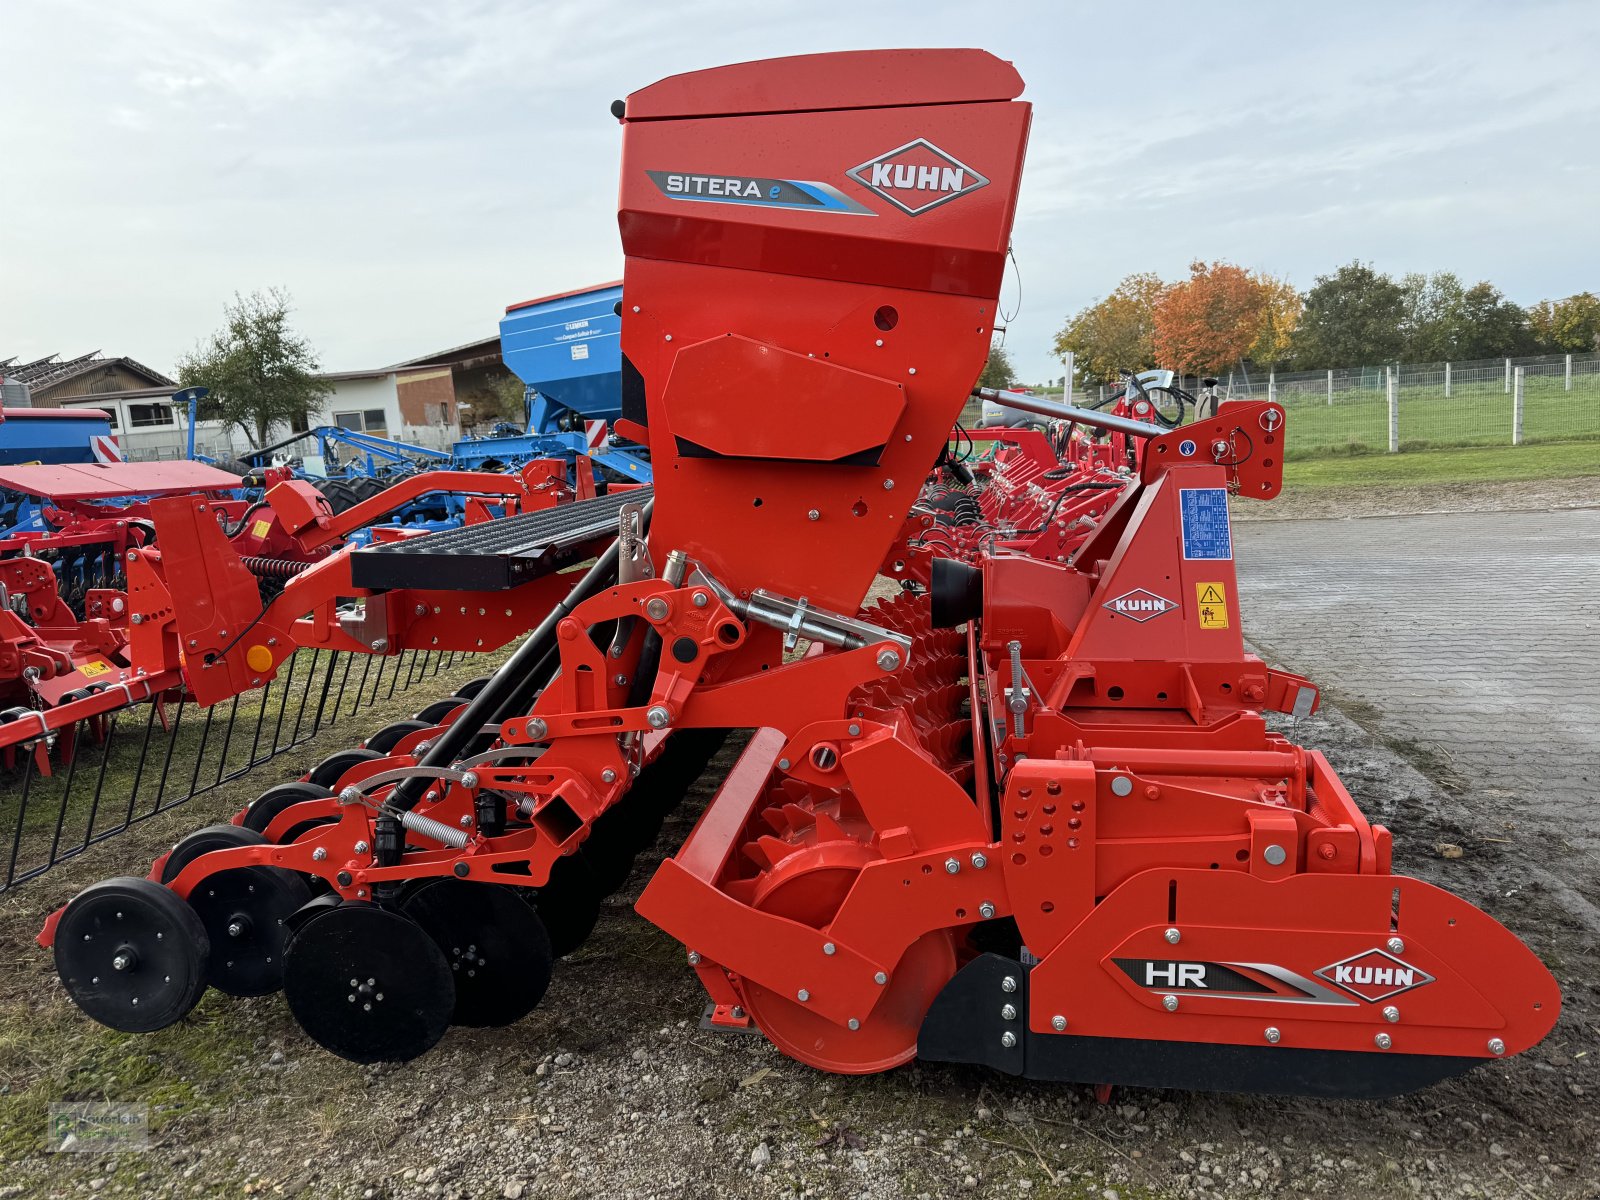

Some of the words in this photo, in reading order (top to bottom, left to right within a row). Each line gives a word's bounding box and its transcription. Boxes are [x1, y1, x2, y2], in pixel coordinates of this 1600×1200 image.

[666, 175, 762, 199] SITERA
[768, 183, 782, 199] e
[870, 163, 964, 193] KUHN
[1115, 599, 1166, 611] KUHN
[1145, 962, 1209, 988] HR
[1335, 965, 1414, 986] KUHN
